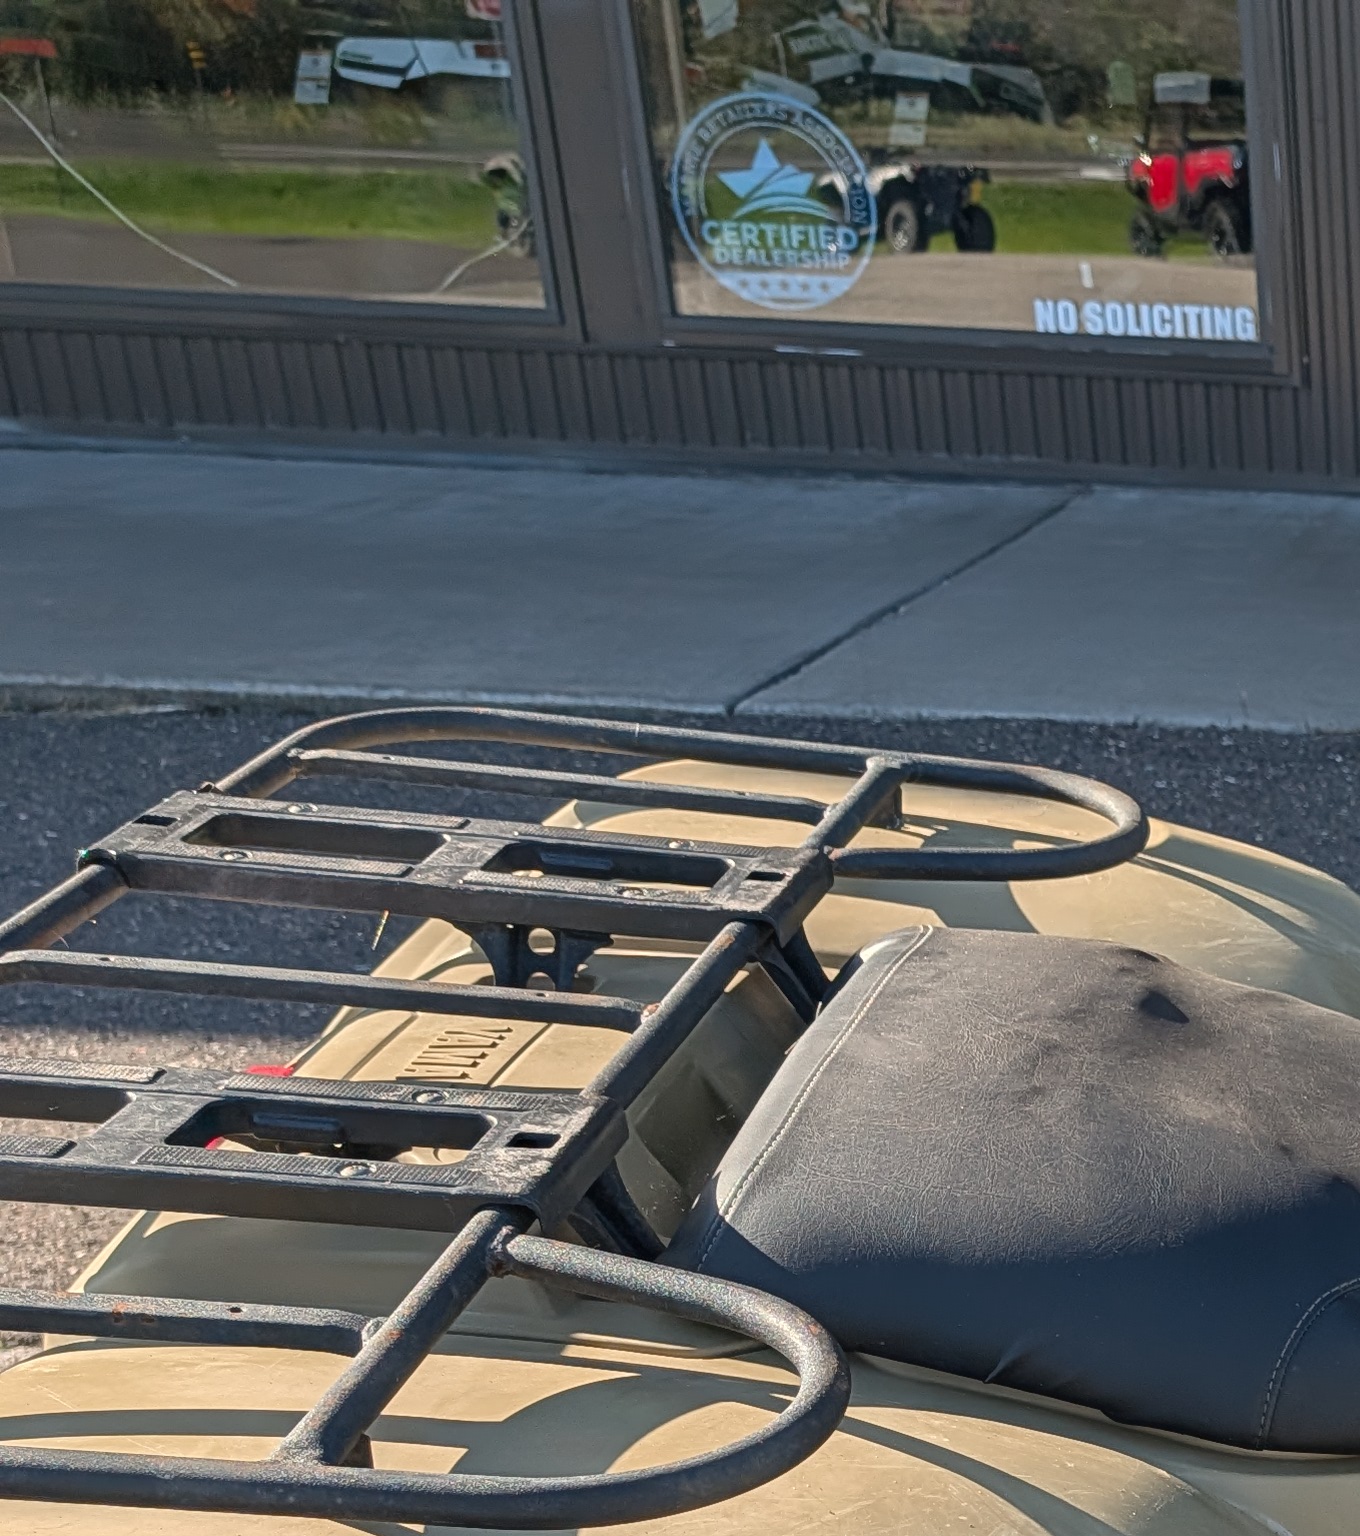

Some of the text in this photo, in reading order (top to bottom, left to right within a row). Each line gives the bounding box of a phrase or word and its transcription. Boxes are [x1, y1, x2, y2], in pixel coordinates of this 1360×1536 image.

[701, 219, 859, 251] CERTIFIED
[714, 246, 852, 269] DEALERSHIP
[1034, 299, 1257, 342] NO SOLICITING
[396, 1026, 514, 1081] YAMA
